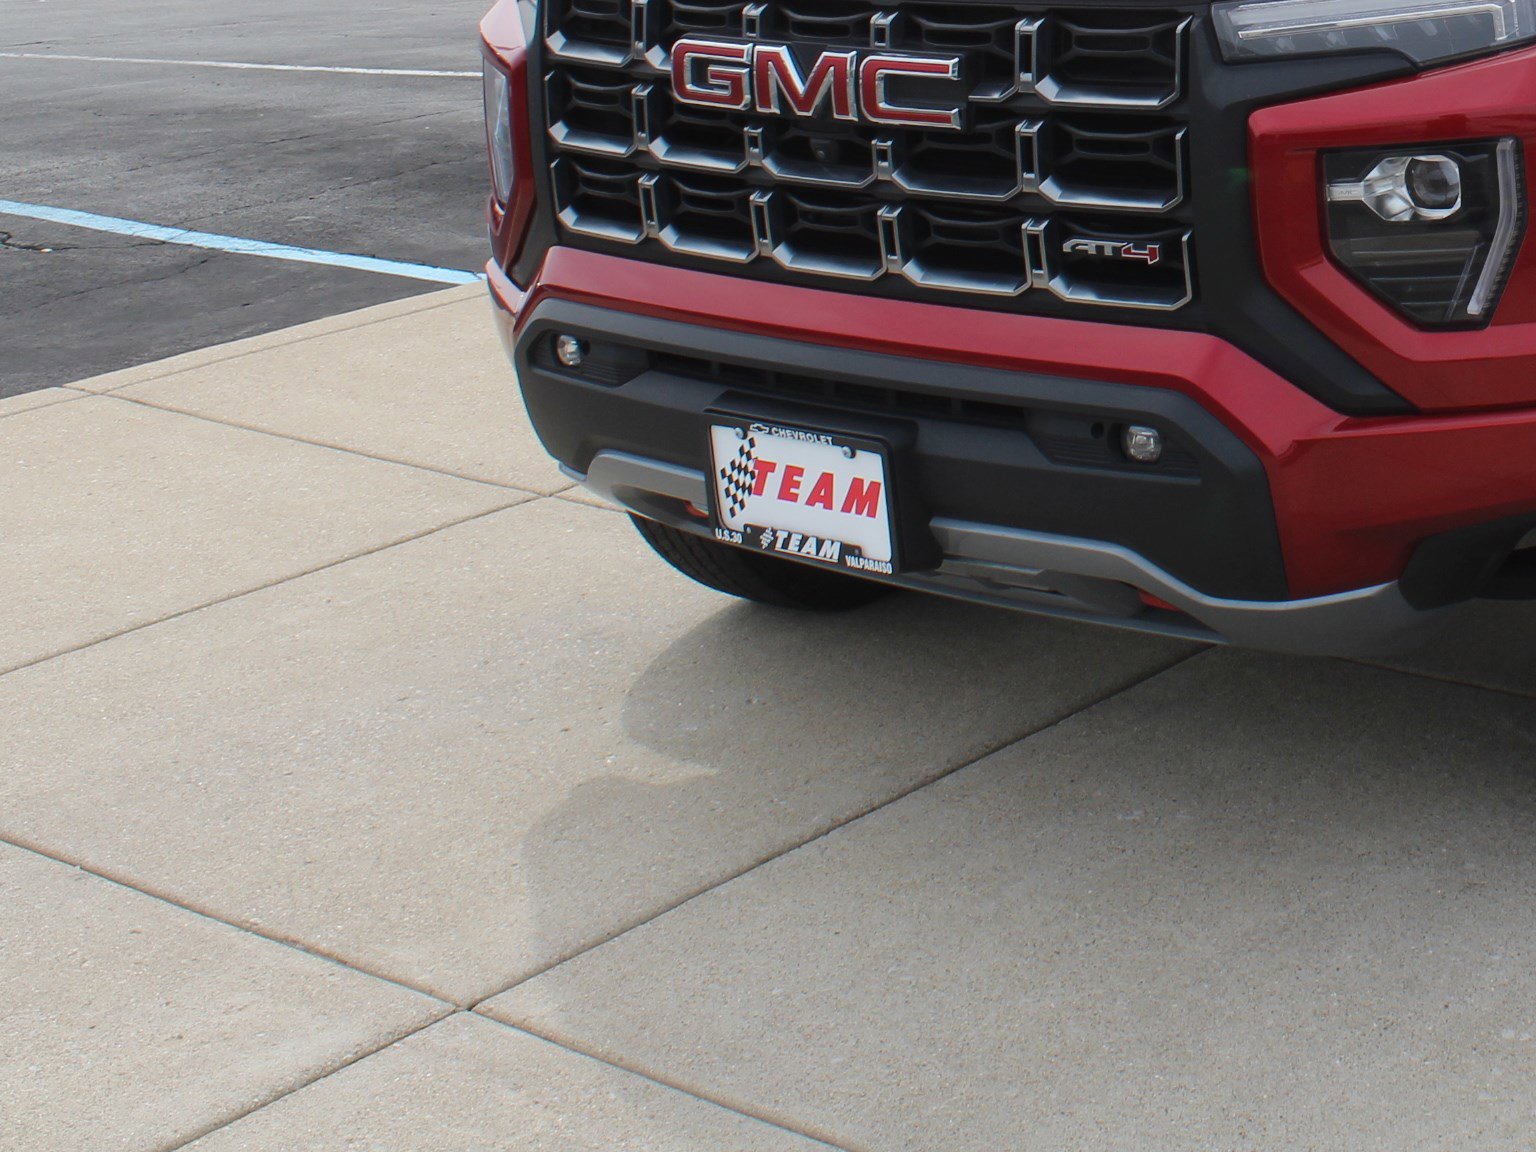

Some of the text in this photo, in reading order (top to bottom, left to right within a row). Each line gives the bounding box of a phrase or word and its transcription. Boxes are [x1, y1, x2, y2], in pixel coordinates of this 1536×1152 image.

[671, 38, 961, 131] GMC
[1062, 238, 1160, 265] AT4
[771, 427, 833, 446] CHEVROLET
[752, 458, 881, 519] TEAM
[774, 529, 842, 560] TEAM
[845, 555, 893, 575] VALPARAISO
